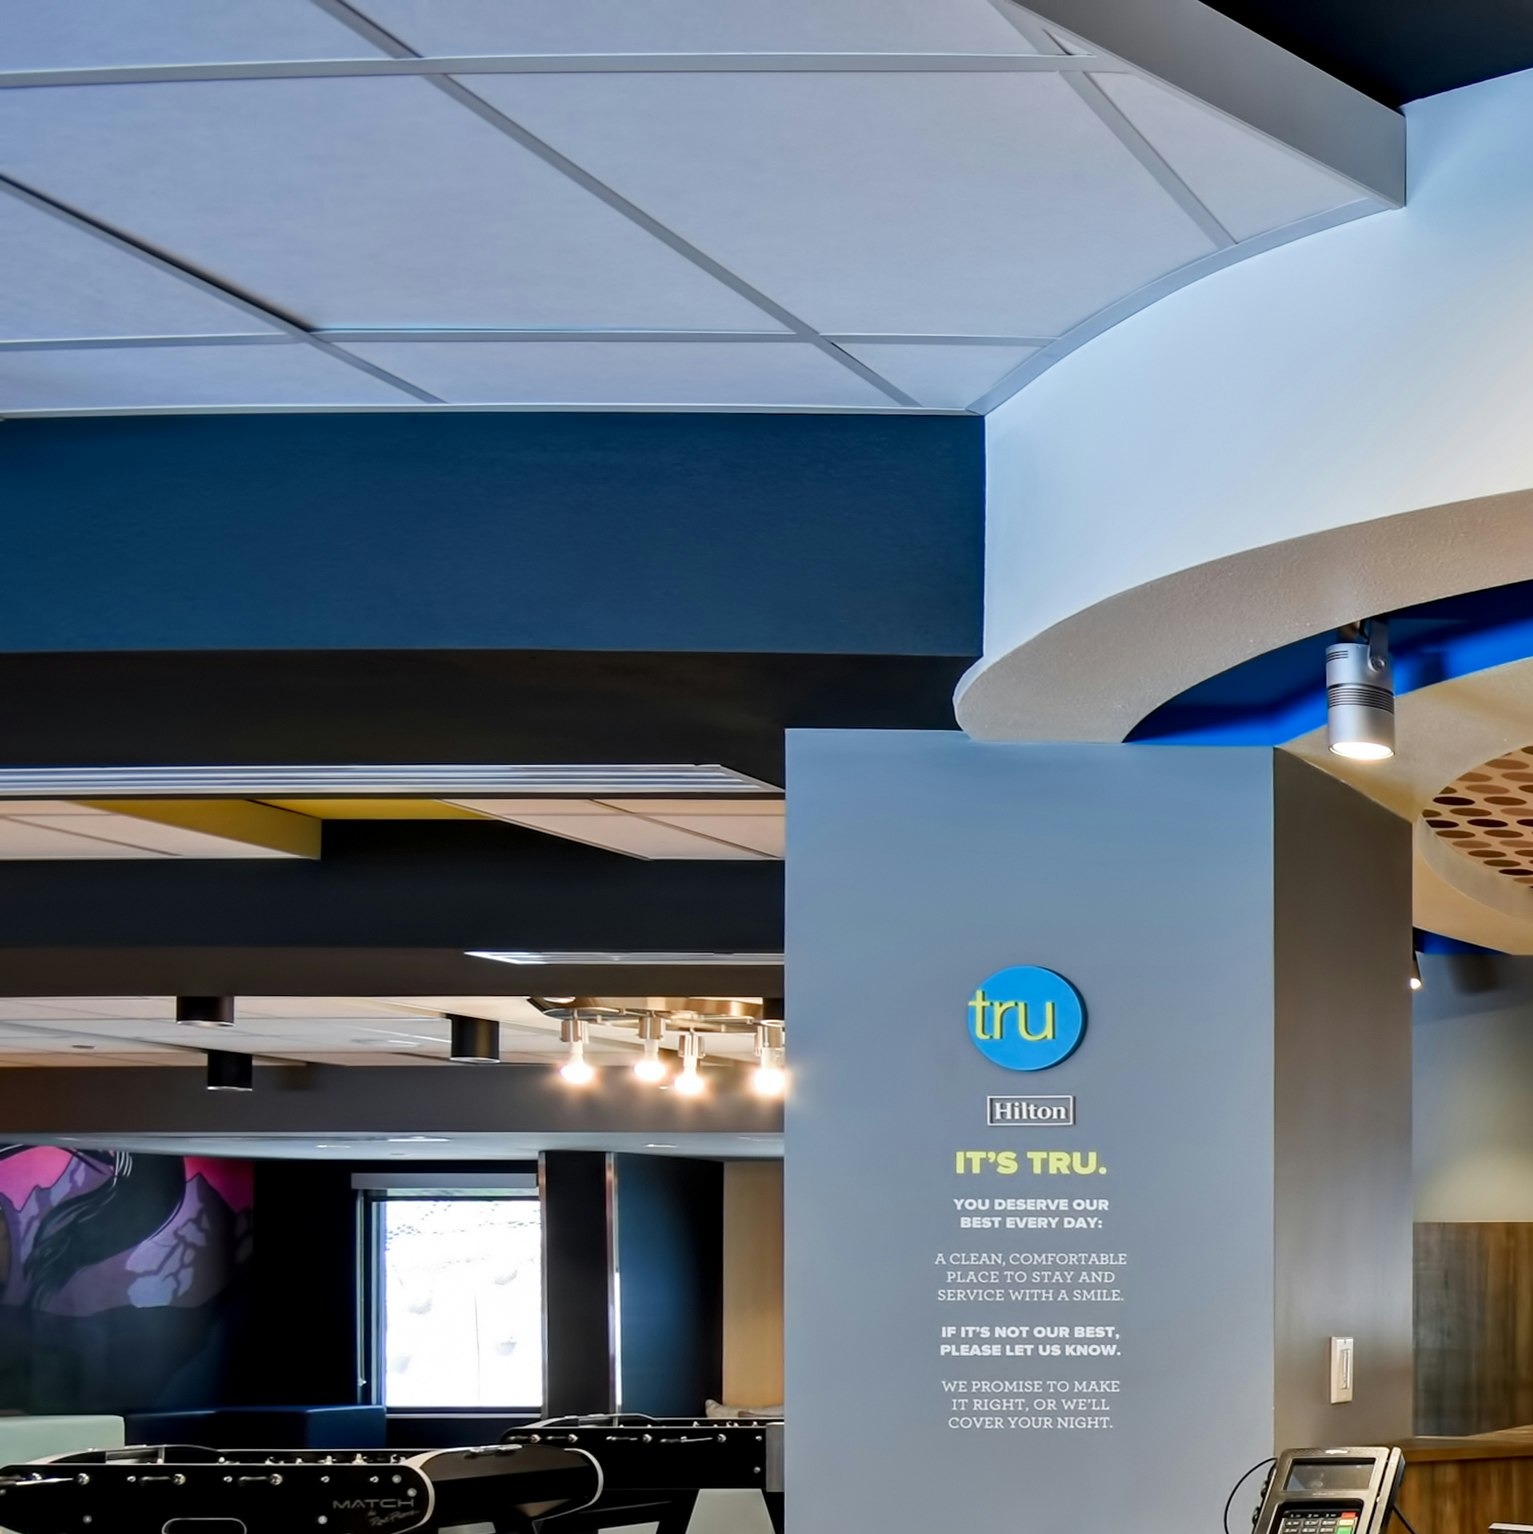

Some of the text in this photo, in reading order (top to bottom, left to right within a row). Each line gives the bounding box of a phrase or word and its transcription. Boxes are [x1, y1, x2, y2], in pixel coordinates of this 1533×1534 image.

[967, 989, 1055, 1042] tru
[994, 1101, 1066, 1120] Hilton
[955, 1151, 1108, 1175] IT'S TRU.
[953, 1198, 1110, 1211] YOU DESERVE OUR
[960, 1216, 1103, 1229] BEST EVERY DAY:
[934, 1252, 1128, 1267] A CLEAN, COMFORTABLE
[946, 1270, 1116, 1283] PLACE TO STAY AND
[937, 1289, 1125, 1302] SERVICE WITH A SMILE.
[941, 1326, 1120, 1340] IF IT'S NOT OUR BEST,
[940, 1344, 1121, 1356] PLEASE LET US KNOW.
[941, 1380, 1121, 1393] WE PROMISE TO MAKE
[951, 1398, 1110, 1412] IT RIGHT, OR WE'LL
[948, 1416, 1114, 1429] COVER YOUR NIGHT.
[333, 1499, 414, 1509] MATCH
